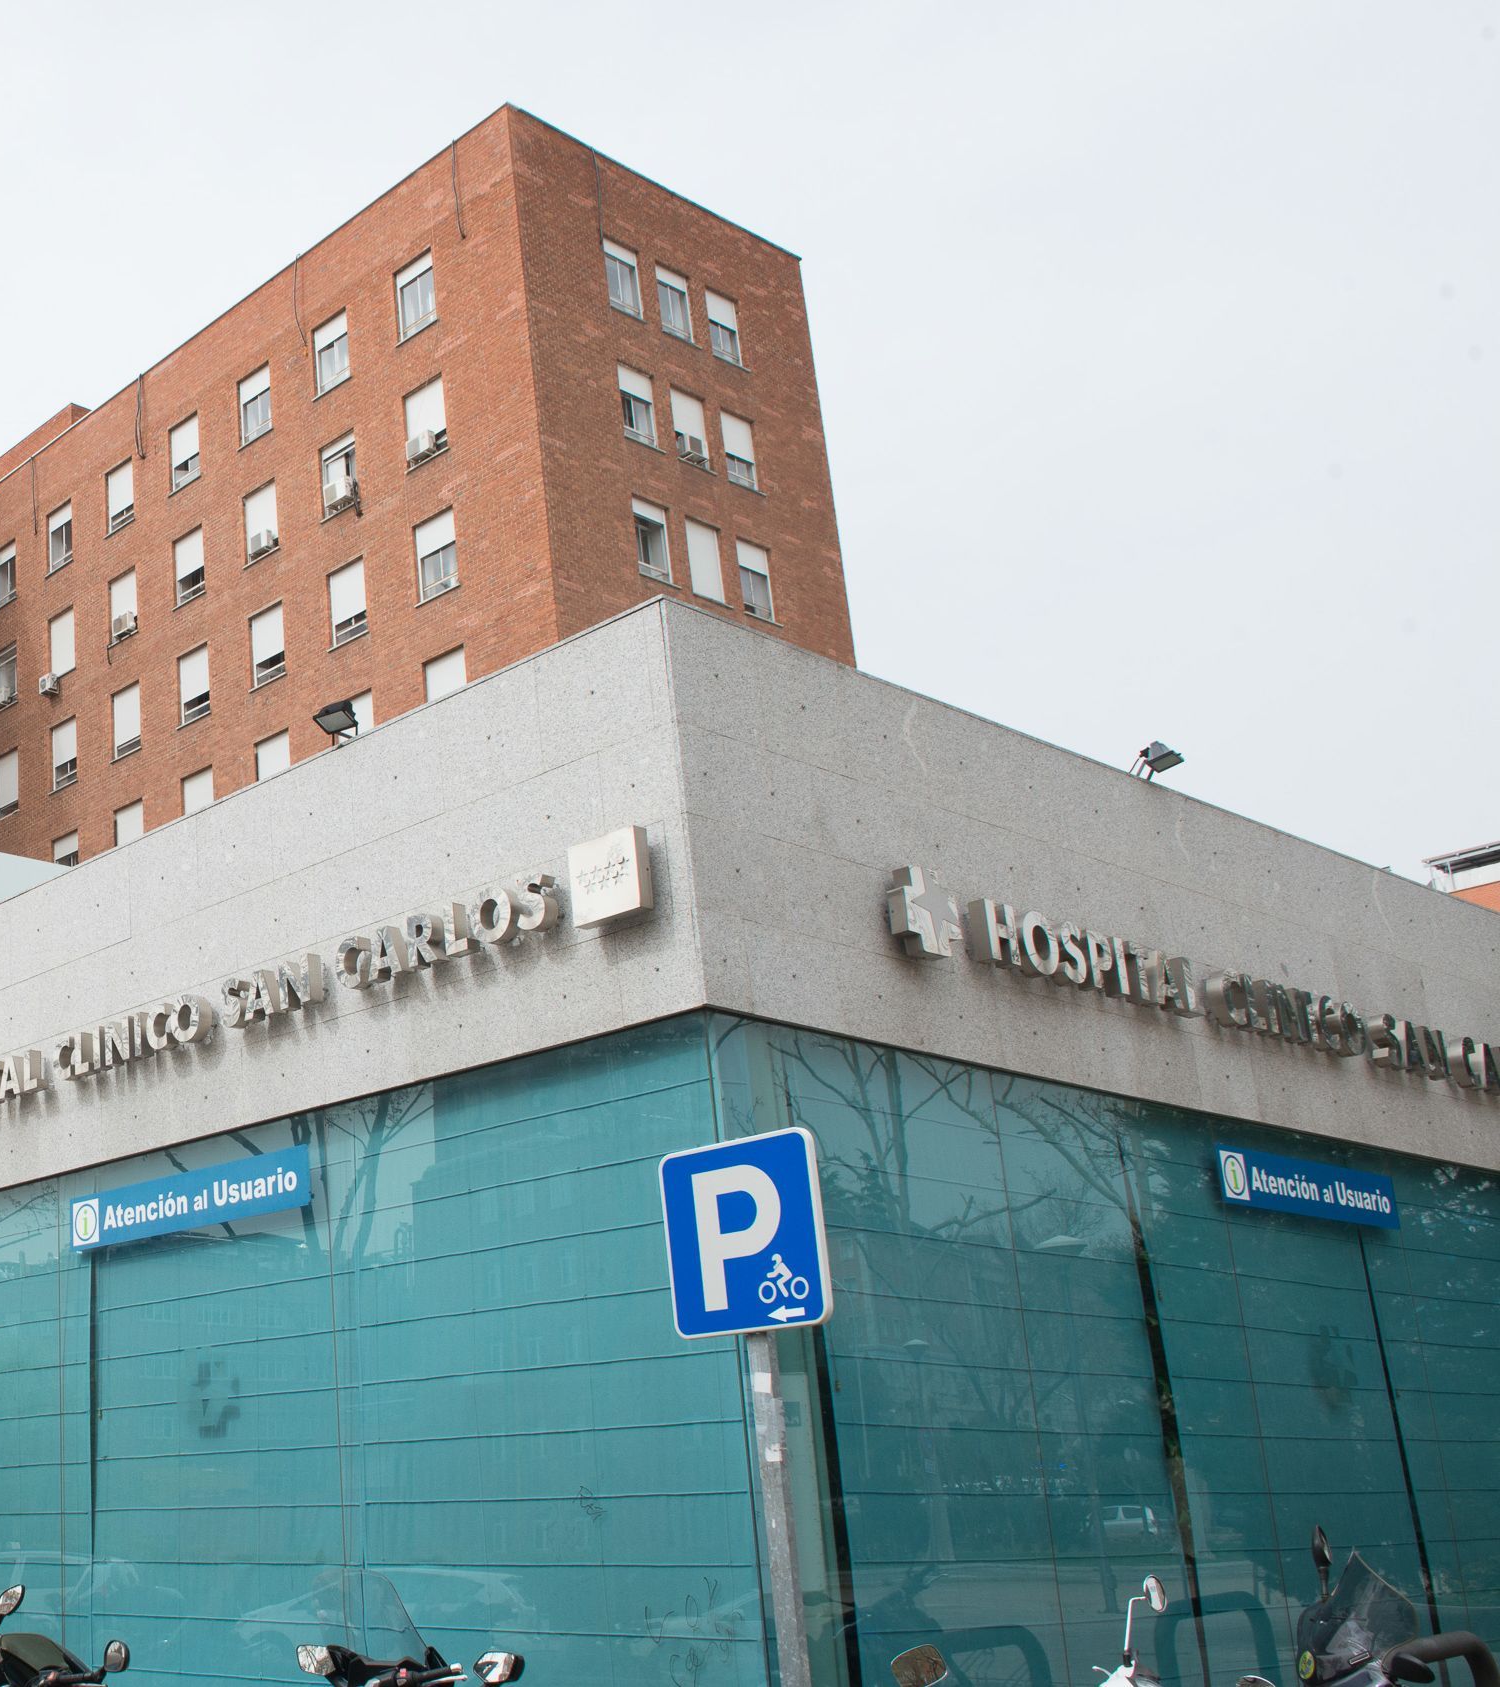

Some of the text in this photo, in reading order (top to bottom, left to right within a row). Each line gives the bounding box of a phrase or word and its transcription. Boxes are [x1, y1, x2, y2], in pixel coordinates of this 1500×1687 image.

[53, 994, 212, 1081] CLINICO
[221, 952, 324, 1028] SAN
[335, 873, 558, 990] CARLOS
[967, 898, 1204, 1018] HOSPITAL
[1367, 1012, 1452, 1081] SAN
[103, 1191, 189, 1231] Atención
[193, 1189, 208, 1212] al
[213, 1166, 298, 1207] Usuario
[691, 1164, 782, 1312] P
[1251, 1165, 1320, 1202] Atención
[1322, 1184, 1335, 1204] al
[1334, 1180, 1391, 1215] Usuario
